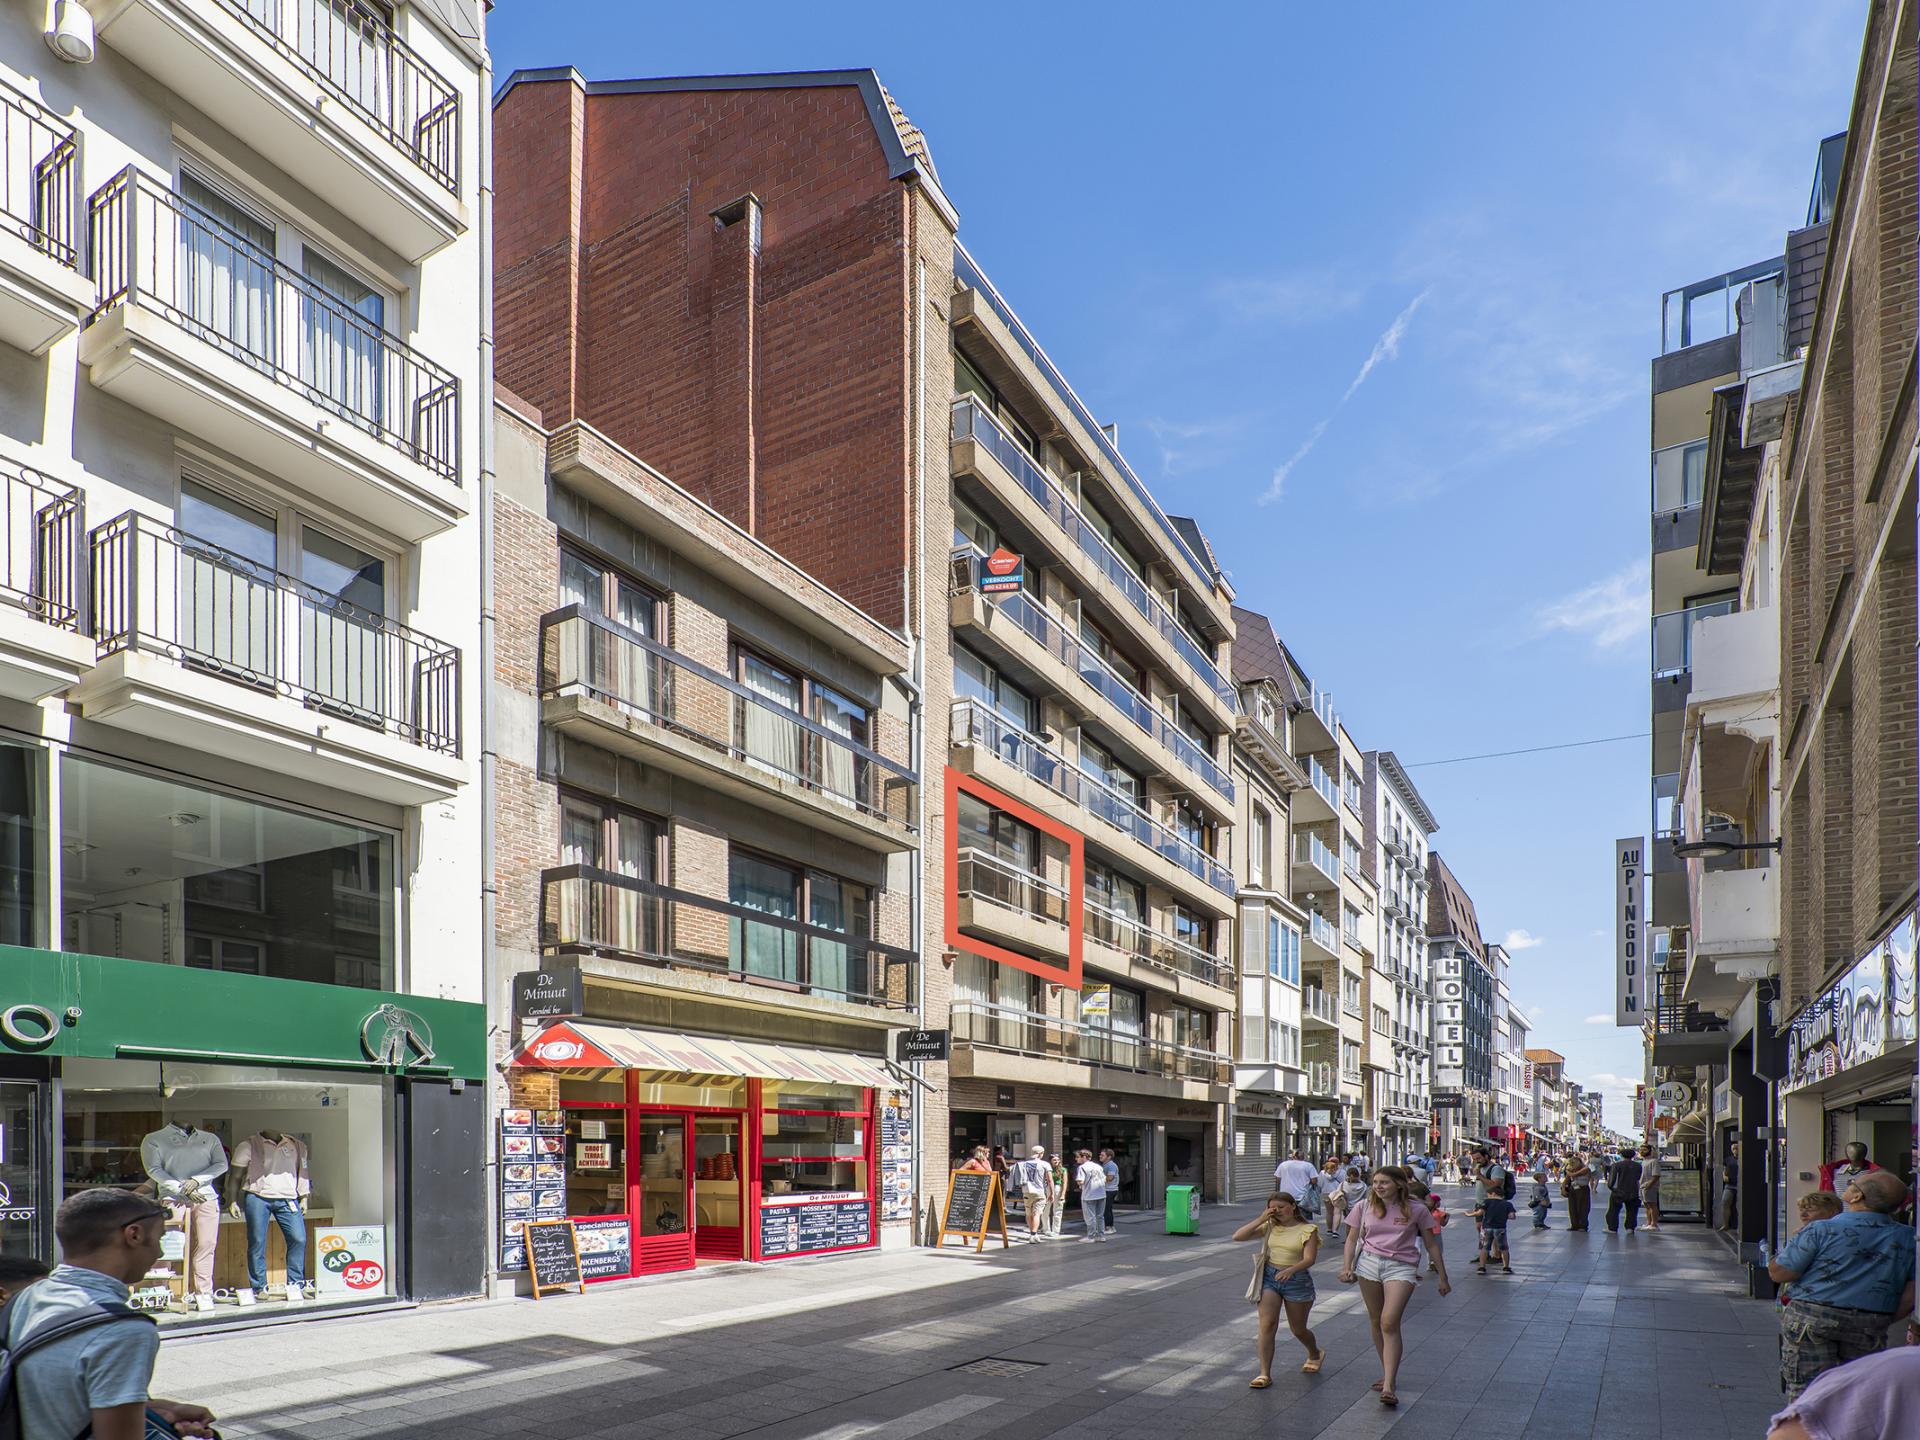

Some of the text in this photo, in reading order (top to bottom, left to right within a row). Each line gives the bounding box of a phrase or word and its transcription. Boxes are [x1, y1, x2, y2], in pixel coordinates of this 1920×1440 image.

[1622, 850, 1639, 864] AU
[1625, 869, 1636, 1012] PINGOUIN
[537, 974, 554, 986] De
[523, 987, 567, 1000] Minuut
[1445, 961, 1461, 1062] HOTEL
[916, 1032, 930, 1041] De
[905, 1042, 941, 1050] Minuut
[1524, 1063, 1532, 1088] BRISTOL
[1661, 1090, 1672, 1098] AU
[578, 1159, 609, 1167] ACHTERAAN
[843, 1203, 864, 1211] SALADES
[579, 1221, 627, 1231] specialiteiten
[320, 1238, 343, 1253] 30
[580, 1255, 621, 1266] NKENBERGS
[581, 1265, 617, 1275] PANNETJE
